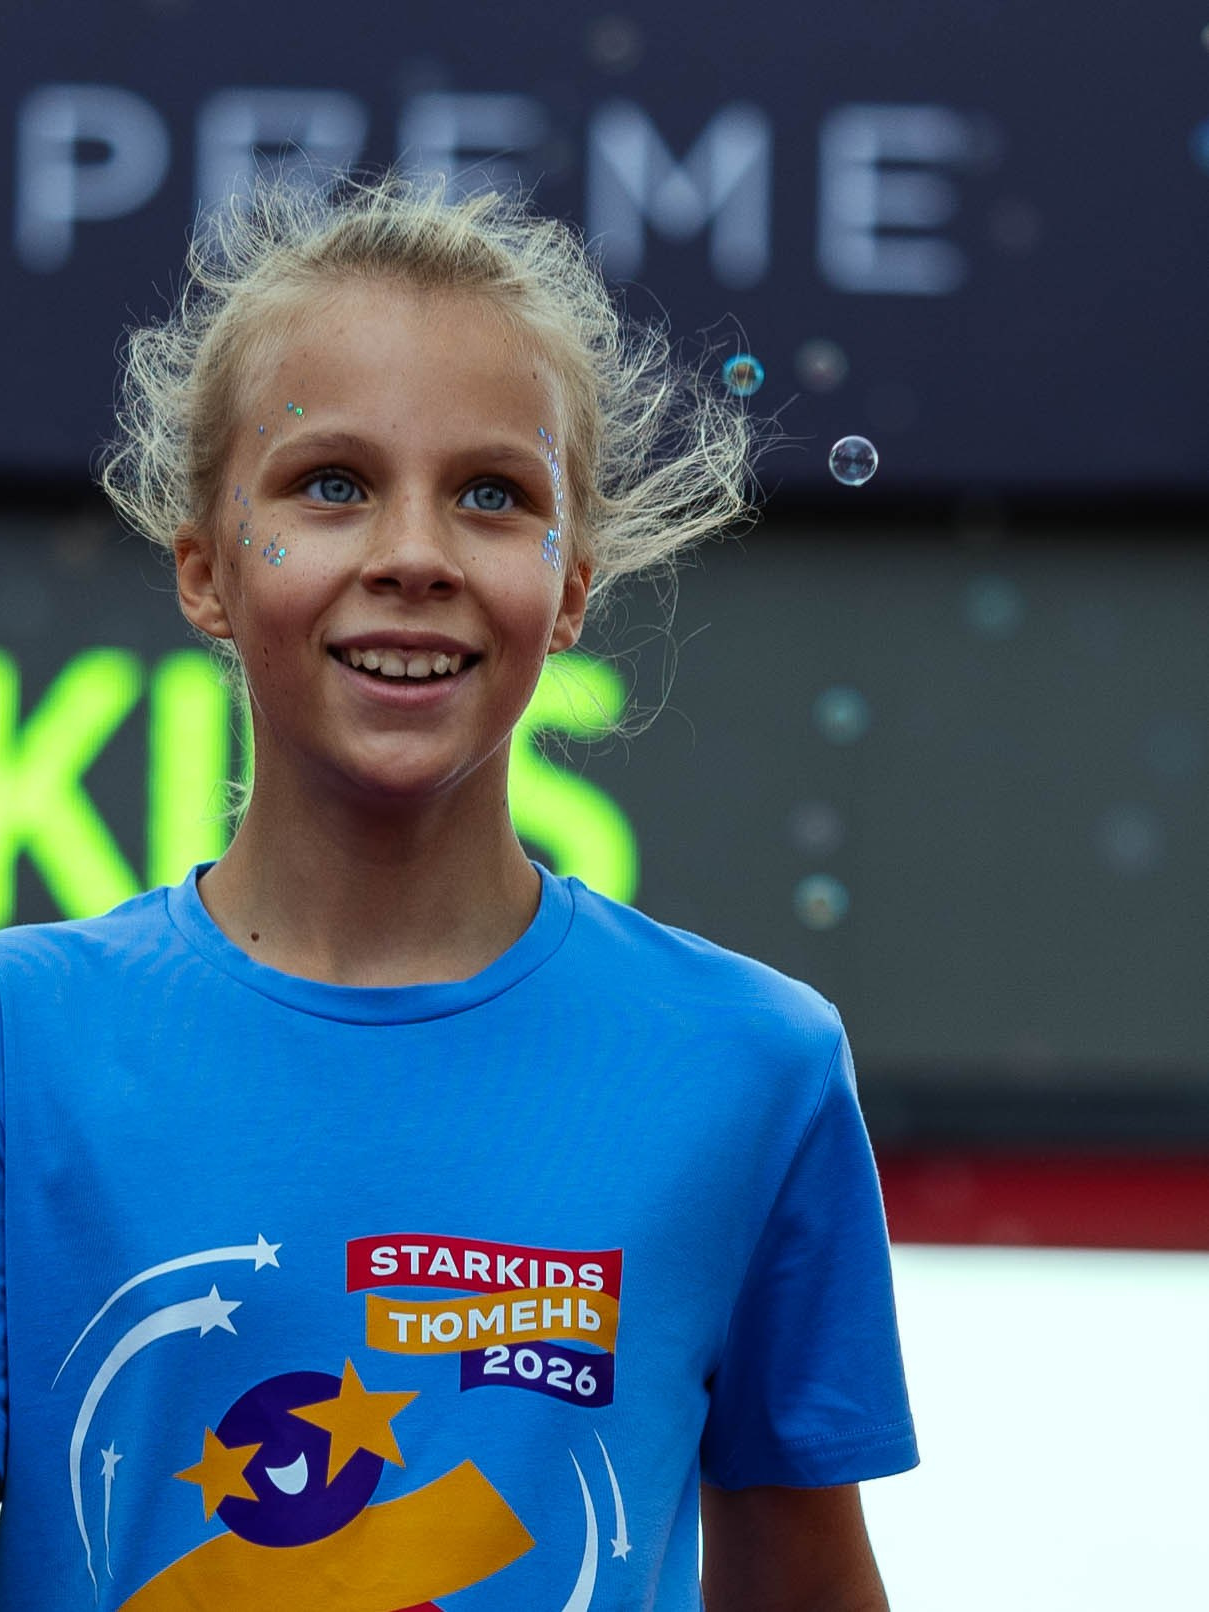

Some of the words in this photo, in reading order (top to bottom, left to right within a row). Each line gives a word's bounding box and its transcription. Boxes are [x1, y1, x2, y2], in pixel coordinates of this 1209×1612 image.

[370, 1245, 604, 1293] STARKIDS
[388, 1298, 601, 1344] ТЮМЕНЬ
[483, 1344, 597, 1397] 2026
